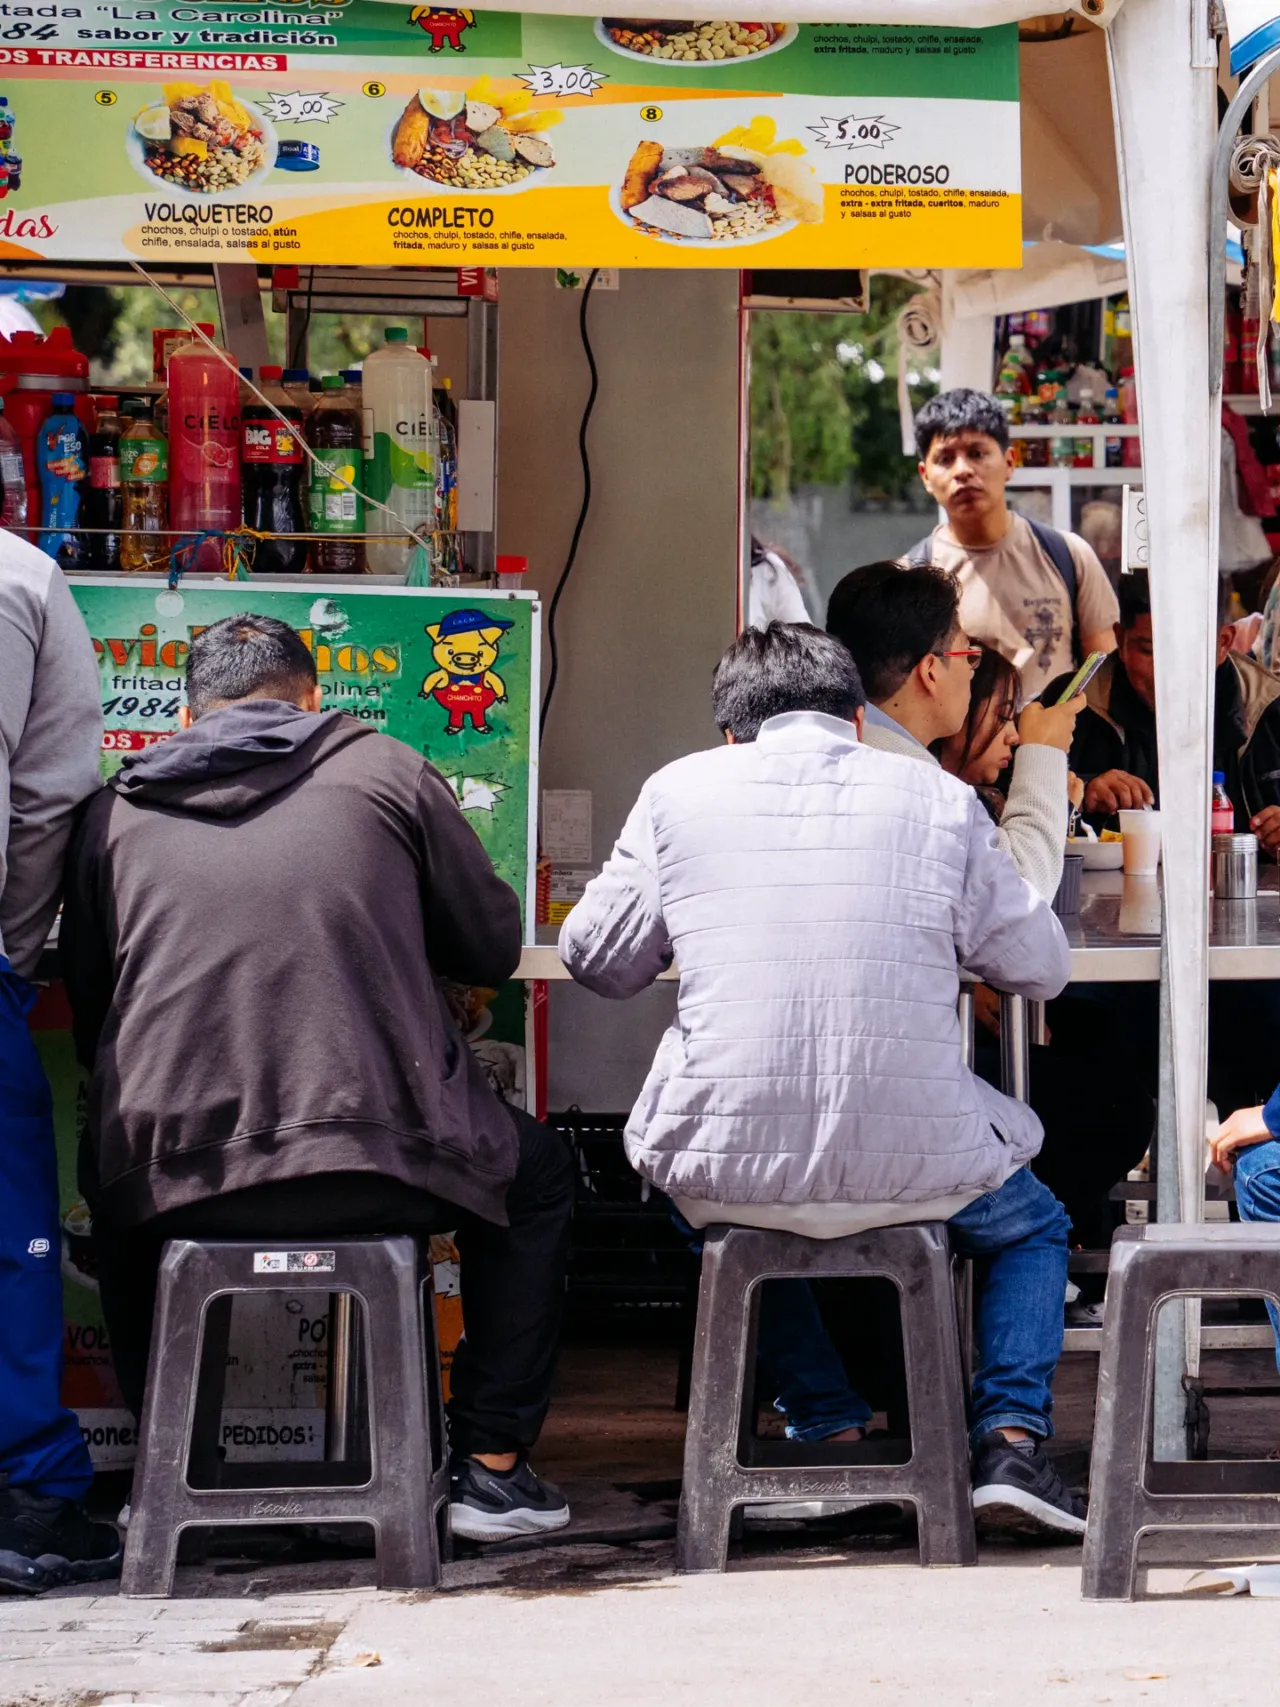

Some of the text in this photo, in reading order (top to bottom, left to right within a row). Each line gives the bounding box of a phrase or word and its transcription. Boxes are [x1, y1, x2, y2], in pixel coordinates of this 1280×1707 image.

[0, 22, 337, 46] 84 sabor y tradición
[813, 35, 850, 44] chochos,
[882, 35, 915, 44] tostado,
[814, 46, 836, 54] extra
[838, 46, 869, 54] fritada,
[871, 46, 903, 54] maduro
[915, 46, 942, 54] salsas
[943, 46, 952, 54] al
[953, 47, 976, 55] gusto
[37, 50, 278, 70] TRANSFERENCIAS
[540, 71, 593, 89] 3.00
[368, 83, 380, 95] 6
[101, 93, 111, 104] 5
[646, 108, 657, 120] 8
[836, 119, 880, 140] 5.00
[844, 164, 950, 185] PODEROSO
[840, 189, 1009, 198] chochos, chulpi, tostado, chifle, ensalada,
[895, 199, 926, 208] fritada,
[928, 199, 966, 208] cueritos,
[968, 199, 1000, 208] maduro
[145, 203, 273, 227] VOLQUETERO
[387, 206, 494, 228] COMPLETO
[841, 210, 912, 219] y salsas al gusto
[141, 225, 297, 237] chochos, chulpi o tostado, atún
[393, 231, 567, 241] chochos, chulpi, tostado, chifle, ensalada,
[142, 237, 301, 251] chifle, ensalada, salsas al gusto
[393, 241, 535, 251] fritada, maduro y salsas al gusto
[245, 429, 272, 446] BIG
[447, 694, 482, 702] CHANCHITO
[102, 695, 181, 718] 1984
[222, 1425, 314, 1446] PEDIDOS:
